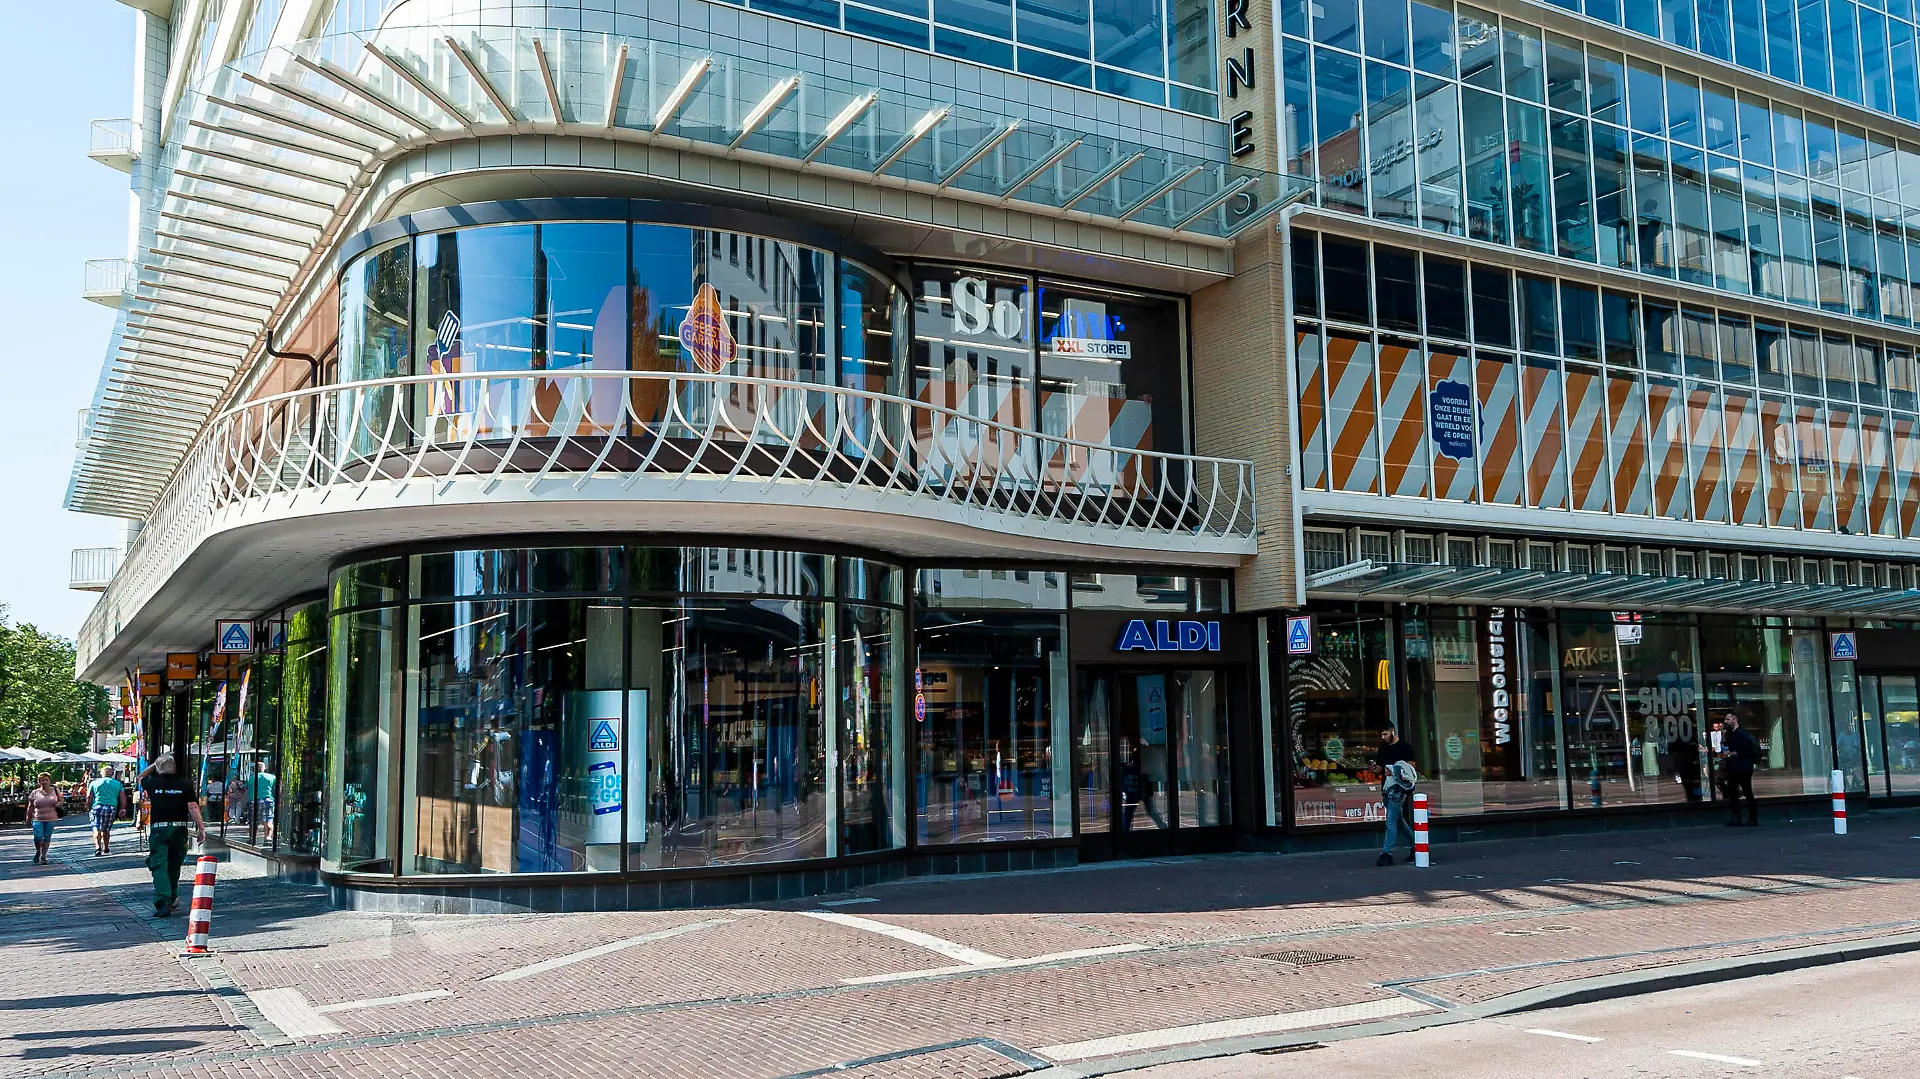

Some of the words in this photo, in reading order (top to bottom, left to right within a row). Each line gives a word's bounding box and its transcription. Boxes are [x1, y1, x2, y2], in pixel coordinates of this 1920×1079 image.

[693, 320, 723, 339] FEEST
[684, 329, 733, 355] GARANTIE
[1056, 340, 1084, 353] XXL
[1087, 343, 1127, 355] STORE!
[1442, 397, 1468, 406] VOORBIJ
[1434, 405, 1451, 413] ONZE
[1452, 406, 1471, 415] DEURE
[1436, 413, 1452, 421] GAAT
[1434, 422, 1460, 430] WERELD
[1452, 432, 1471, 440] OPEN!
[1116, 620, 1221, 651] ALDI
[1638, 687, 1695, 715] SHOP
[1645, 715, 1660, 743] &
[1663, 715, 1692, 743] GO
[600, 789, 621, 802] GO
[1296, 800, 1335, 821] ACTIE!
[1345, 808, 1362, 817] vers
